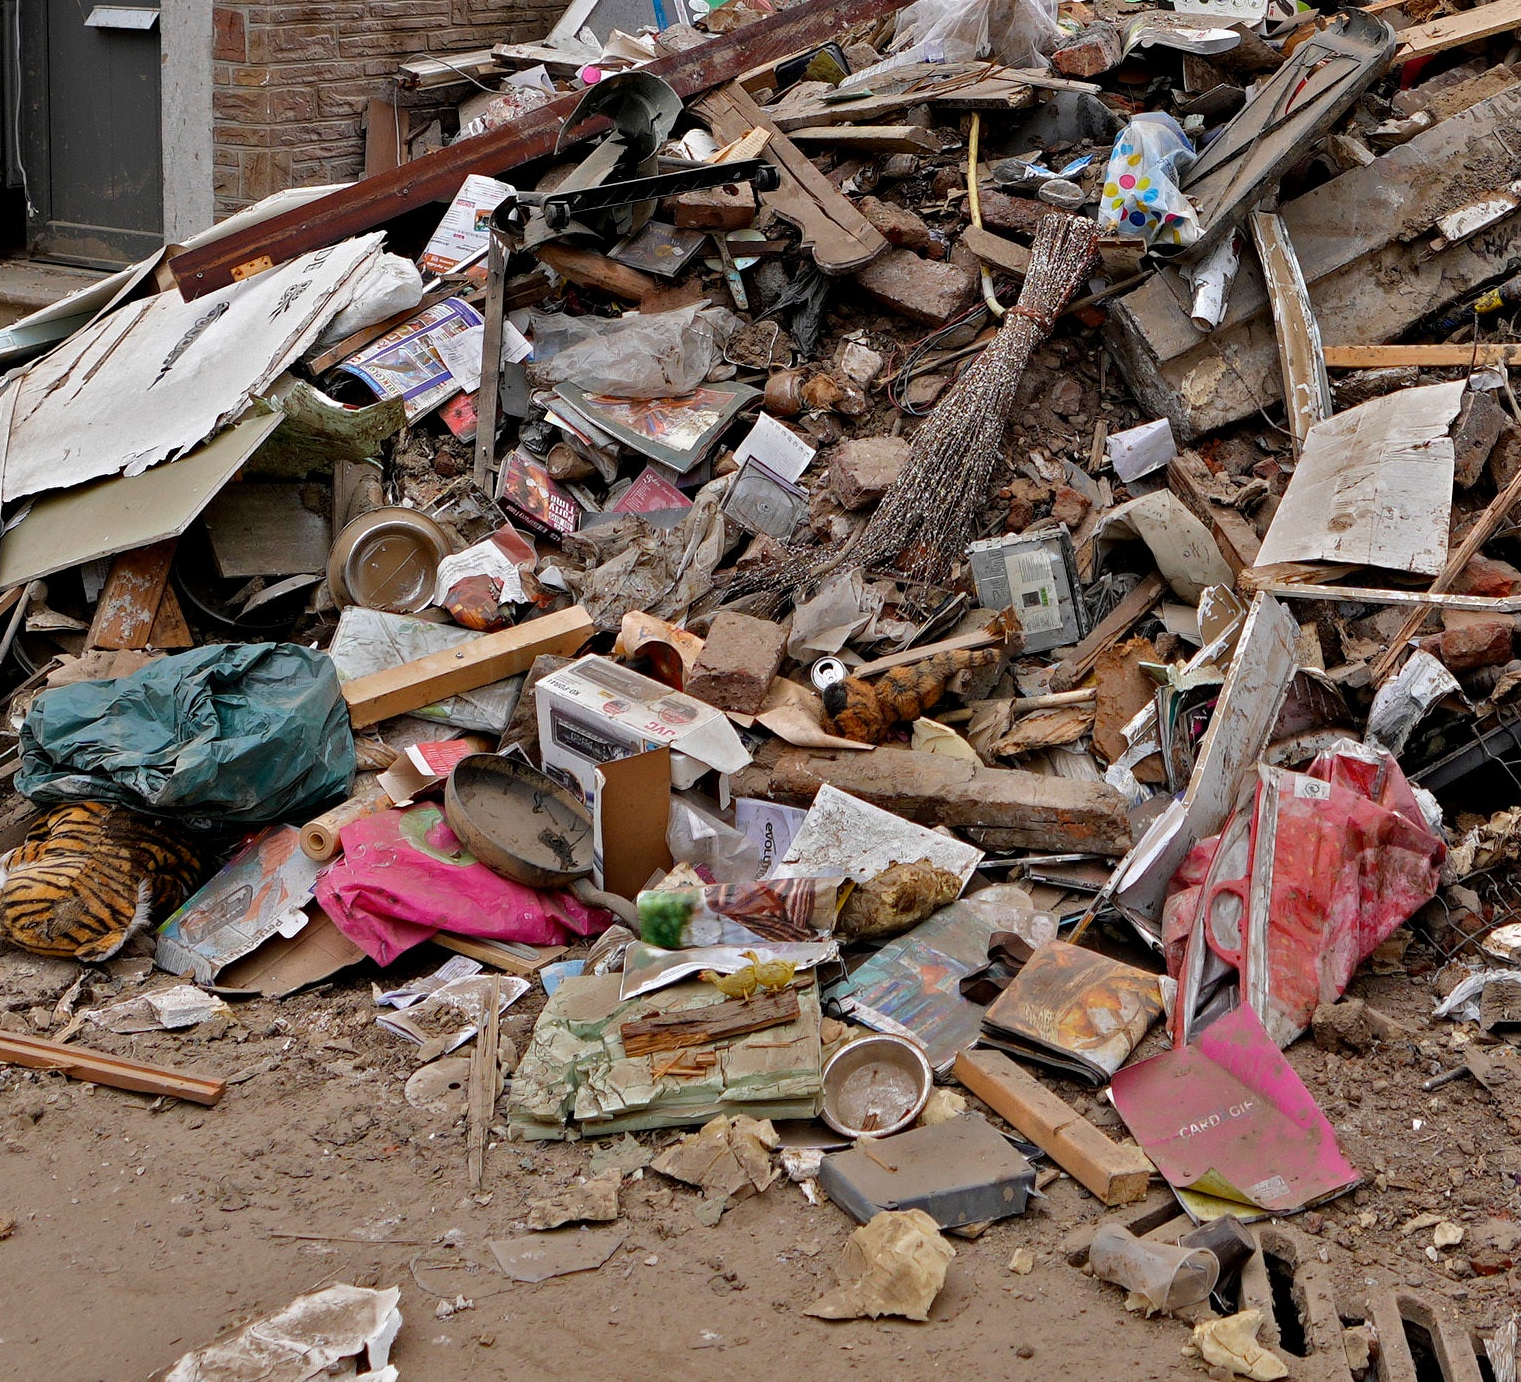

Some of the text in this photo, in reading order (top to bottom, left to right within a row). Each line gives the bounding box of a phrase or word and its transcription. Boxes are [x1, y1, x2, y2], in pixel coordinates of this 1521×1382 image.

[644, 721, 677, 737] JVC
[1179, 1096, 1258, 1139] CARD GIF
